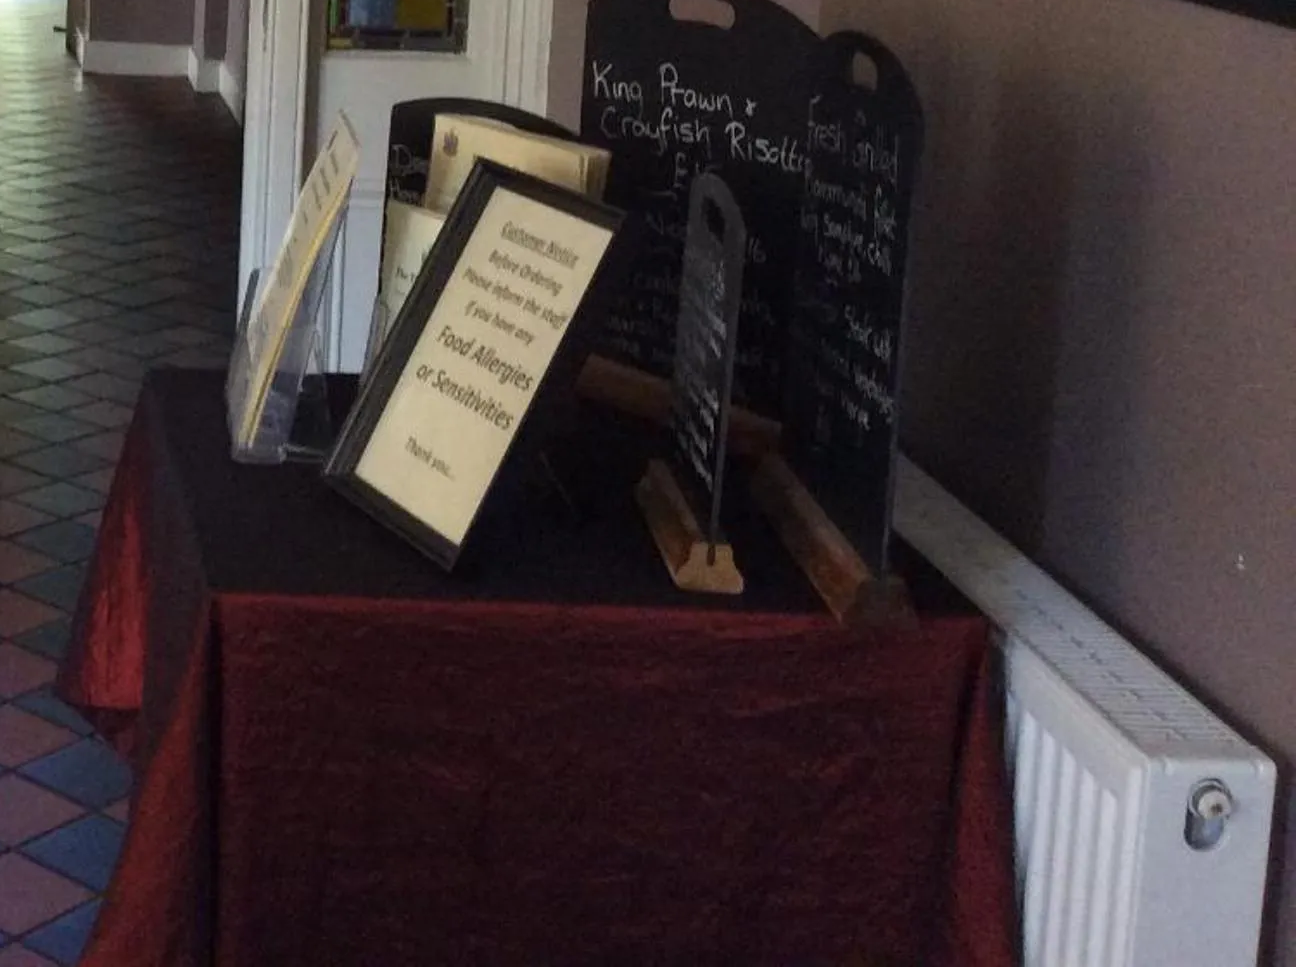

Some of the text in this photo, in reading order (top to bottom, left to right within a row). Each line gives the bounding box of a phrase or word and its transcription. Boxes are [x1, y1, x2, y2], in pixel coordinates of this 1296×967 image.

[591, 60, 645, 118] King
[658, 62, 734, 118] Prawn
[437, 325, 535, 393] Food Allergies
[415, 362, 515, 431] or Sensitivities
